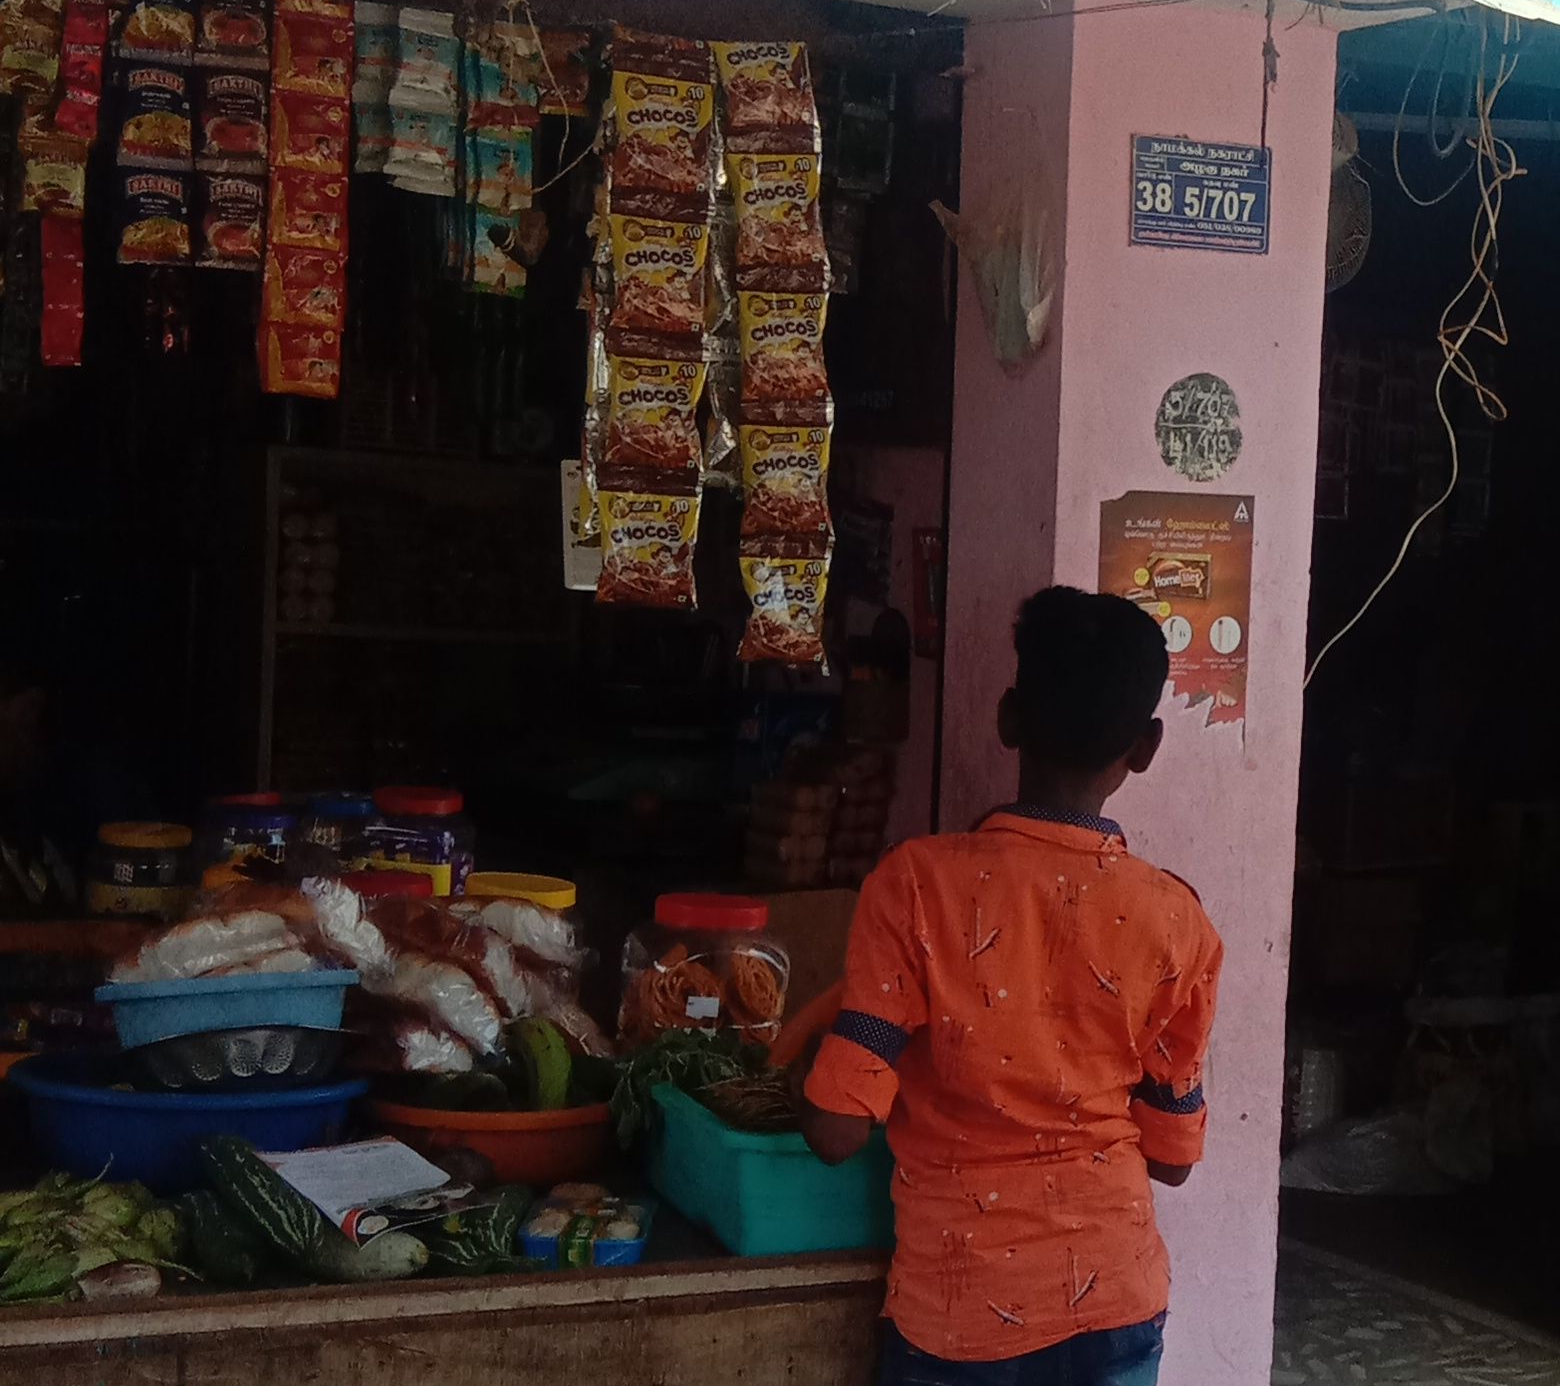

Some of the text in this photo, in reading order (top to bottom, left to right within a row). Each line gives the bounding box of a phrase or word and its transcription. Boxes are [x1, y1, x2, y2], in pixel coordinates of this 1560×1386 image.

[727, 44, 789, 65] CHOCOS
[627, 109, 697, 125] CHOCOS
[744, 183, 806, 204] CHOCOS
[1137, 181, 1256, 222] 38 5/707
[625, 249, 695, 267] CHOCOS
[751, 320, 817, 341] CHOCOS
[618, 388, 689, 404] CHOCOS
[753, 454, 818, 475] CHOCOS
[611, 524, 680, 543] CHOCOS
